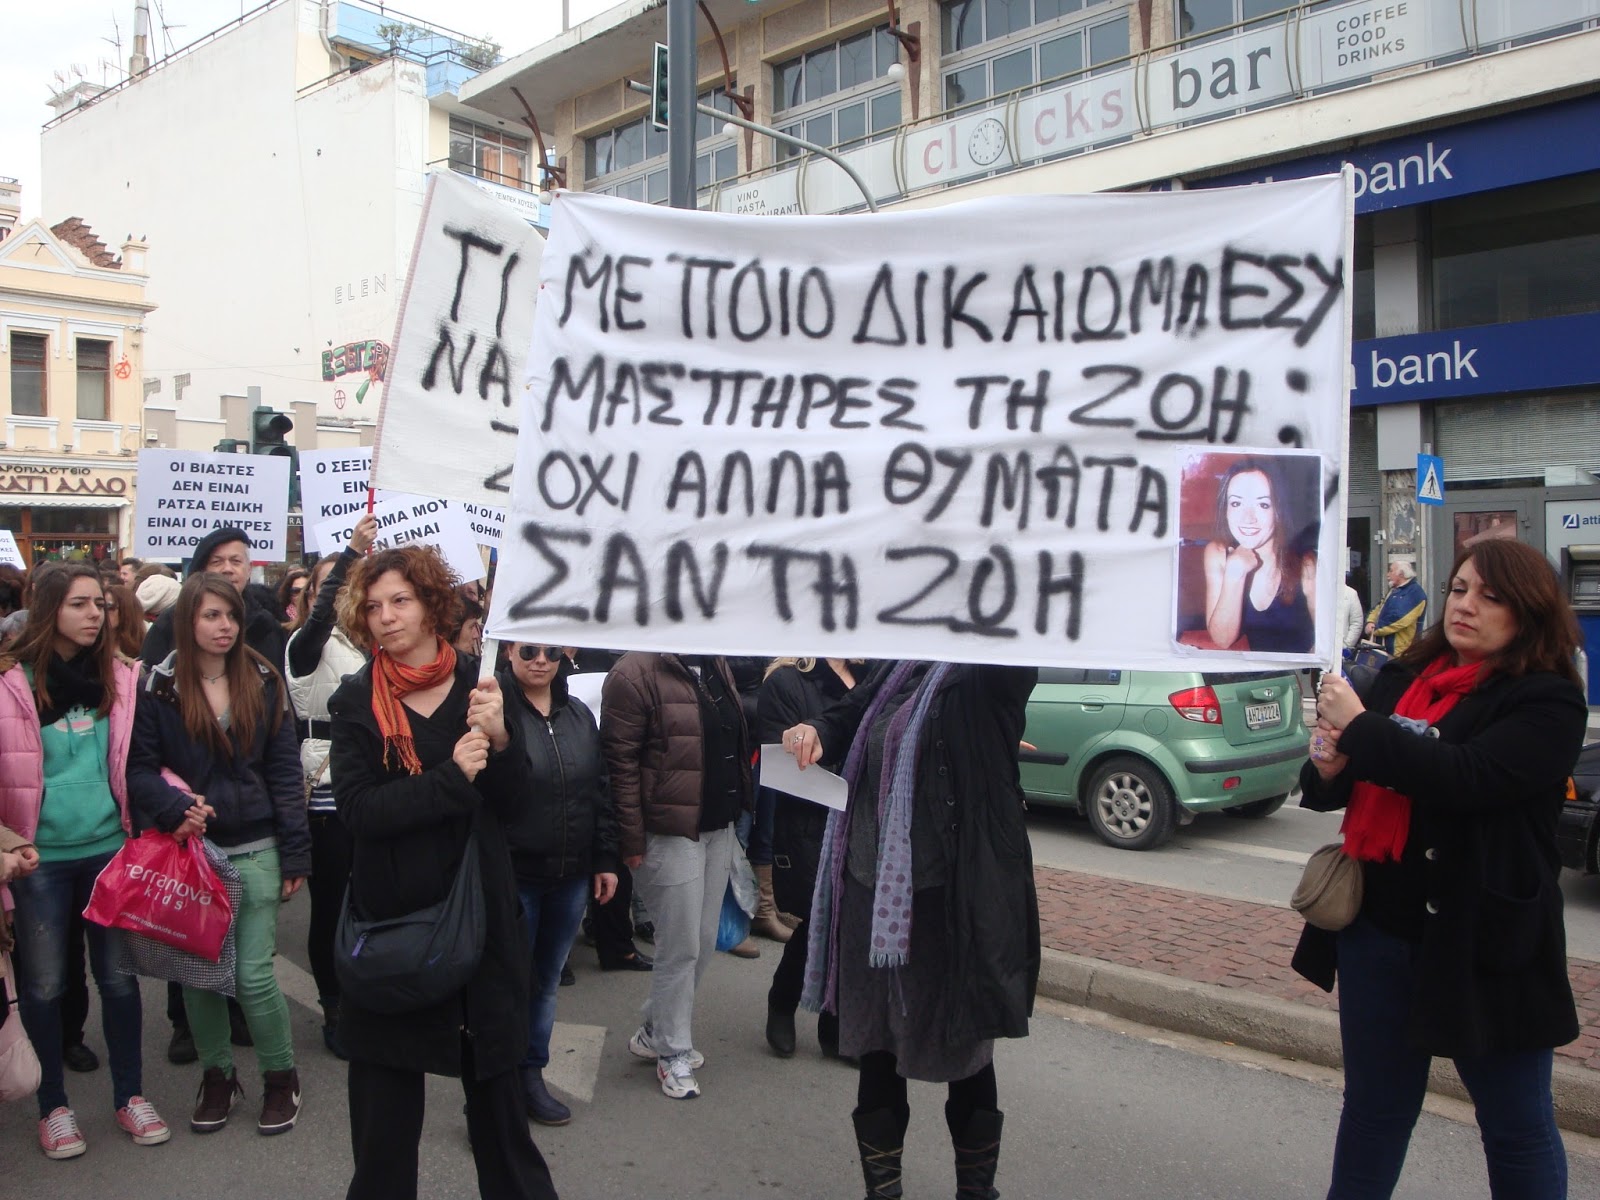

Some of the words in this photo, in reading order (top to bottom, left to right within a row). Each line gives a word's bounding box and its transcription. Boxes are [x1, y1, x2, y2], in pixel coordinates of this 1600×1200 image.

[1337, 2, 1407, 32] COFFEE
[1337, 26, 1386, 50] FOOD
[1338, 38, 1405, 67] DRINKS
[1171, 46, 1271, 111] bar
[737, 189, 759, 203] VINO
[738, 200, 766, 214] PASTA
[559, 253, 653, 333] ΜΕ
[667, 253, 835, 342] ΠΟΙΟ
[1220, 246, 1343, 348] ΕΣΥ
[1371, 340, 1479, 388] bank
[541, 354, 685, 433] ΜΑΣ
[690, 369, 926, 431] ΠΗΡΕΣ
[955, 369, 1051, 432] ΤΗ
[170, 462, 185, 472] ΟΙ
[190, 463, 255, 476] ΒΙΑΣΤΕΣ
[316, 462, 326, 474] Ο
[172, 481, 203, 492] ΔΕΝ
[208, 482, 249, 494] ΕΙΝΑΙ
[343, 480, 370, 493] ΕΙΝ
[537, 450, 639, 515] ΟΧΙ
[883, 441, 1168, 538] ΘΥΜΑΤΑ
[158, 499, 206, 510] ΡΑΤΣΑ
[211, 501, 263, 513] ΕΙΔΙΚΗ
[464, 502, 477, 515] ΑΙ
[480, 508, 492, 519] ΟΙ
[148, 517, 186, 528] ΕΙΝΑΙ
[192, 518, 207, 529] ΟΙ
[212, 519, 272, 532] ΑΝΤΡΕΣ
[331, 528, 354, 543] ΤΟ
[375, 510, 409, 529] ΩΜΑ
[412, 499, 449, 518] ΜΟΥ
[470, 522, 503, 539] ΑΘΗΜ
[148, 536, 162, 546] ΟΙ
[393, 522, 441, 546] ΕΙΝΑΙ
[508, 521, 729, 627] ΣΑΝ
[743, 540, 859, 631] ΤΗ
[144, 885, 184, 911] kids
